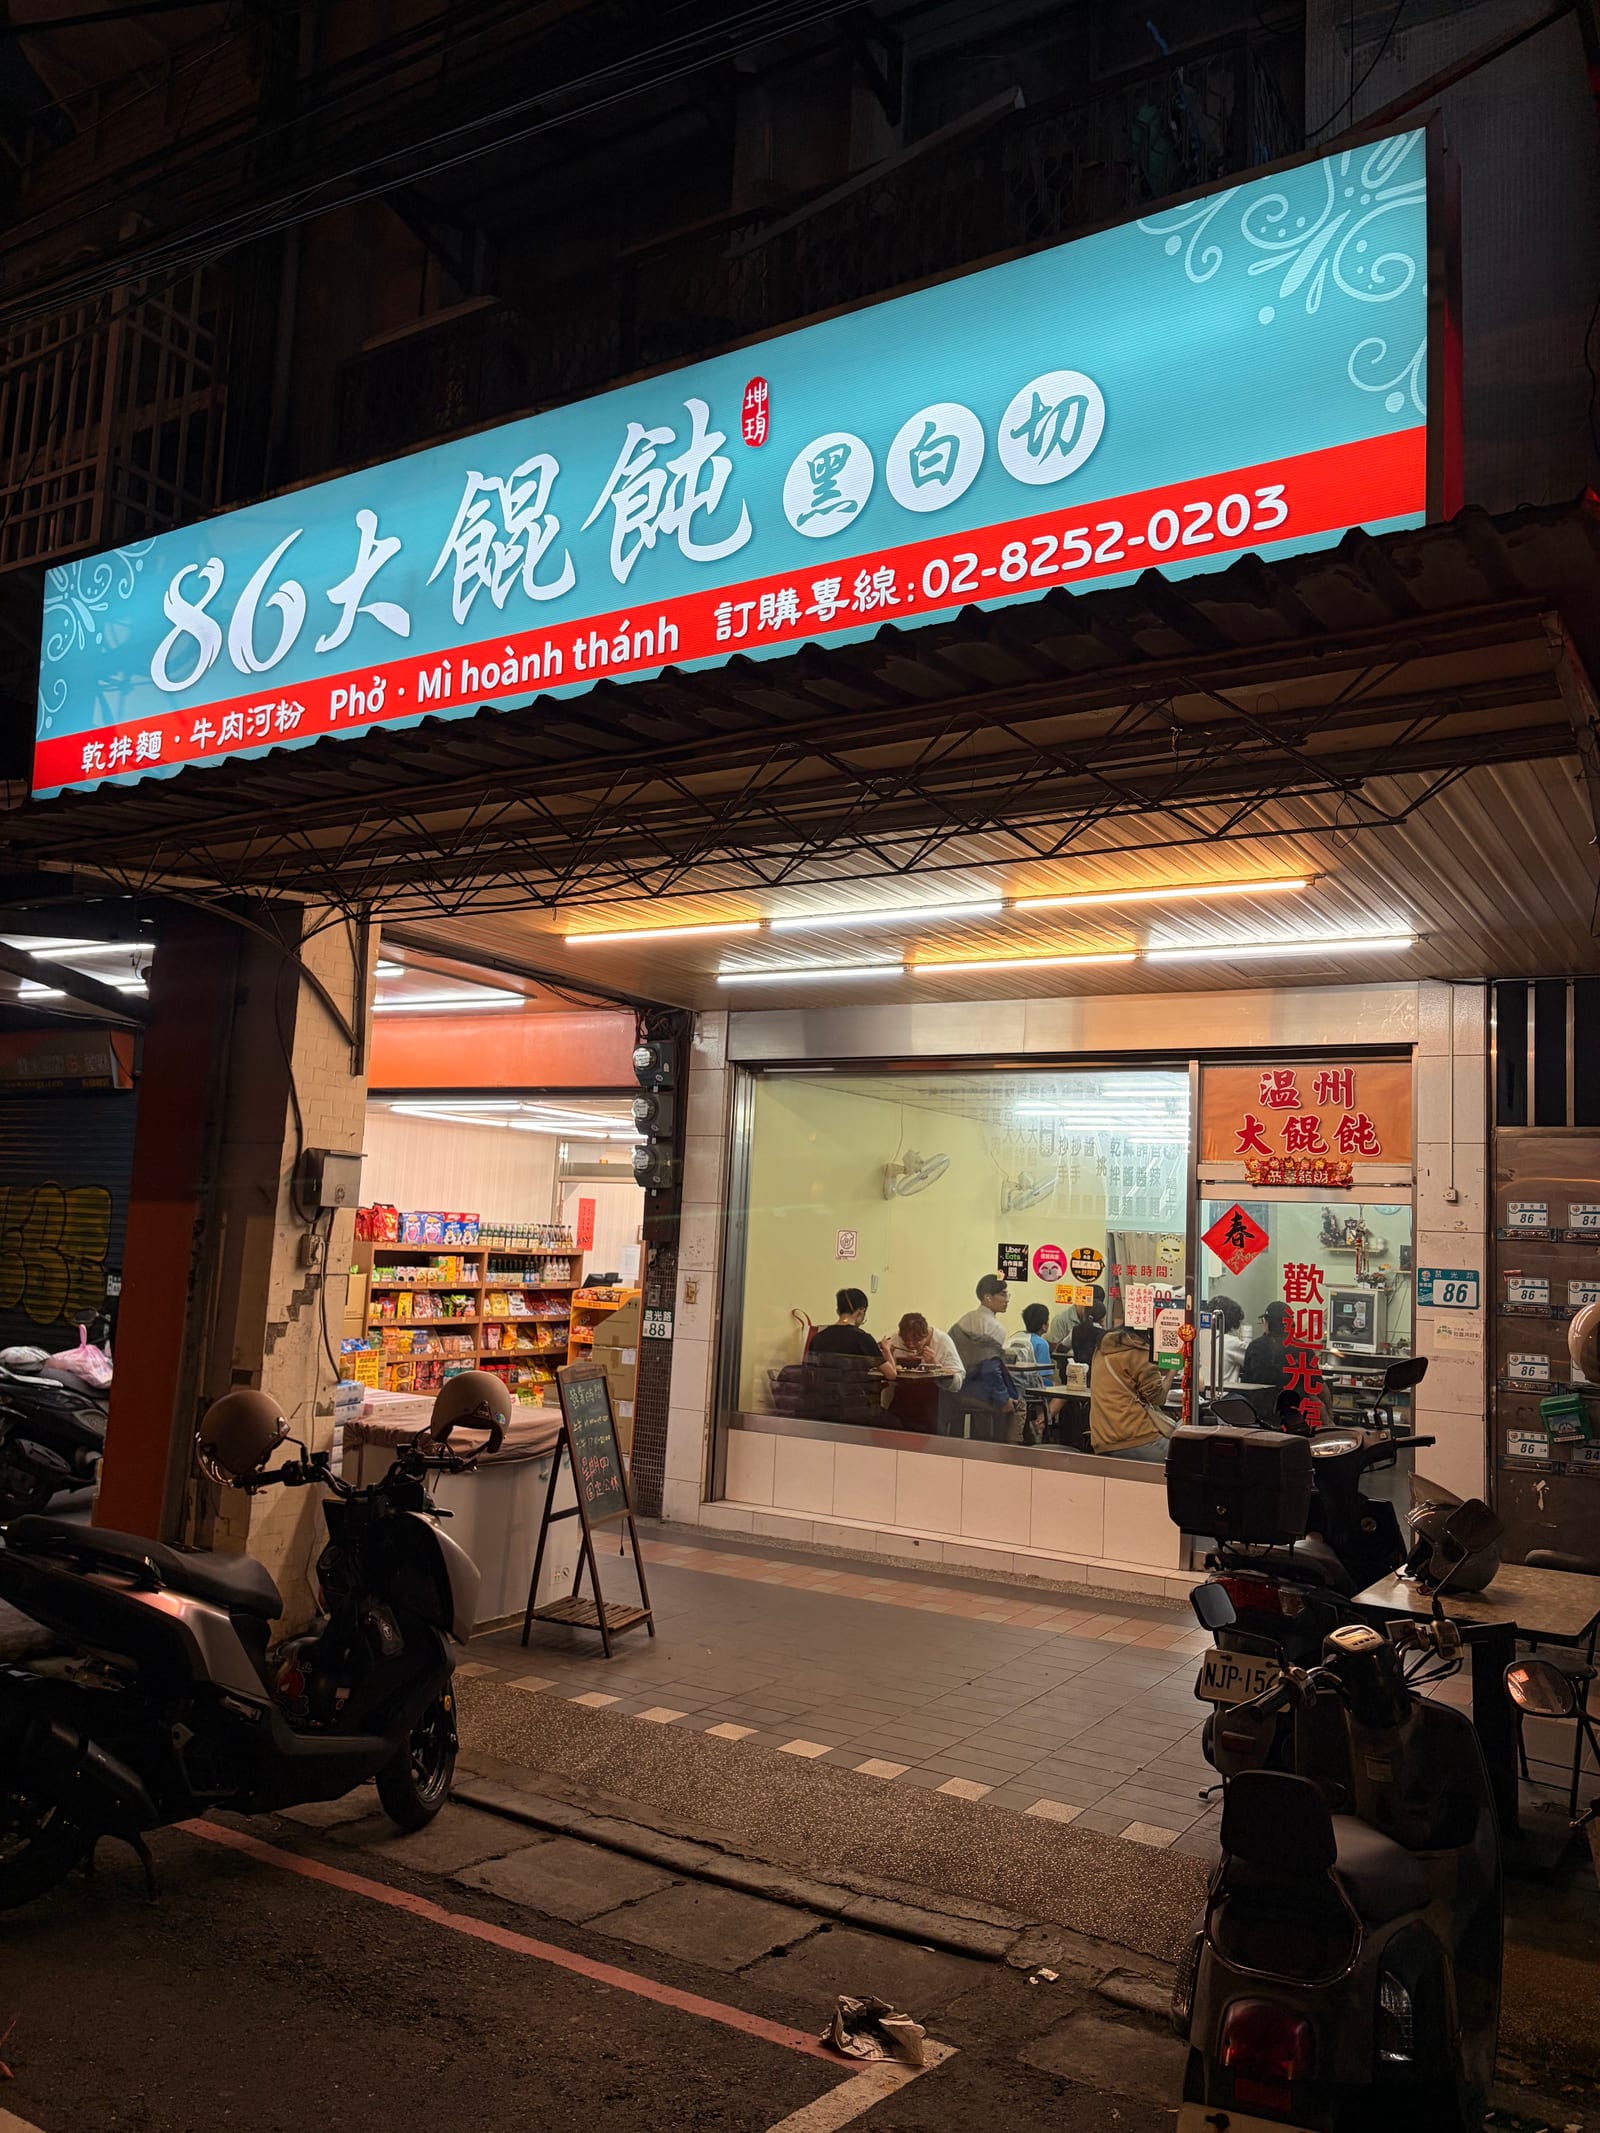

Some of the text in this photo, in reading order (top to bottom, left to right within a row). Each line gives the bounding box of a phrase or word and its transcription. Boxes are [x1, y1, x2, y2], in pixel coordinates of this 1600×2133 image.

[796, 391, 1089, 527] 黑白切
[150, 398, 753, 692] 86大餛飩
[329, 615, 680, 721] Phở Mì hoành thánh
[81, 699, 306, 774] 乾拌麵 牛肉河粉
[1234, 1113, 1381, 1157] 大餛飩
[1520, 1213, 1535, 1224] 86
[1582, 1215, 1598, 1226] 84
[1223, 1210, 1256, 1249] 春
[1005, 1246, 1021, 1254] Uber
[1443, 1282, 1469, 1303] 86
[1521, 1289, 1536, 1300] 86
[1581, 1293, 1597, 1303] 84
[648, 1322, 666, 1337] 88
[1521, 1366, 1536, 1377] 86
[1520, 1443, 1535, 1454] 86
